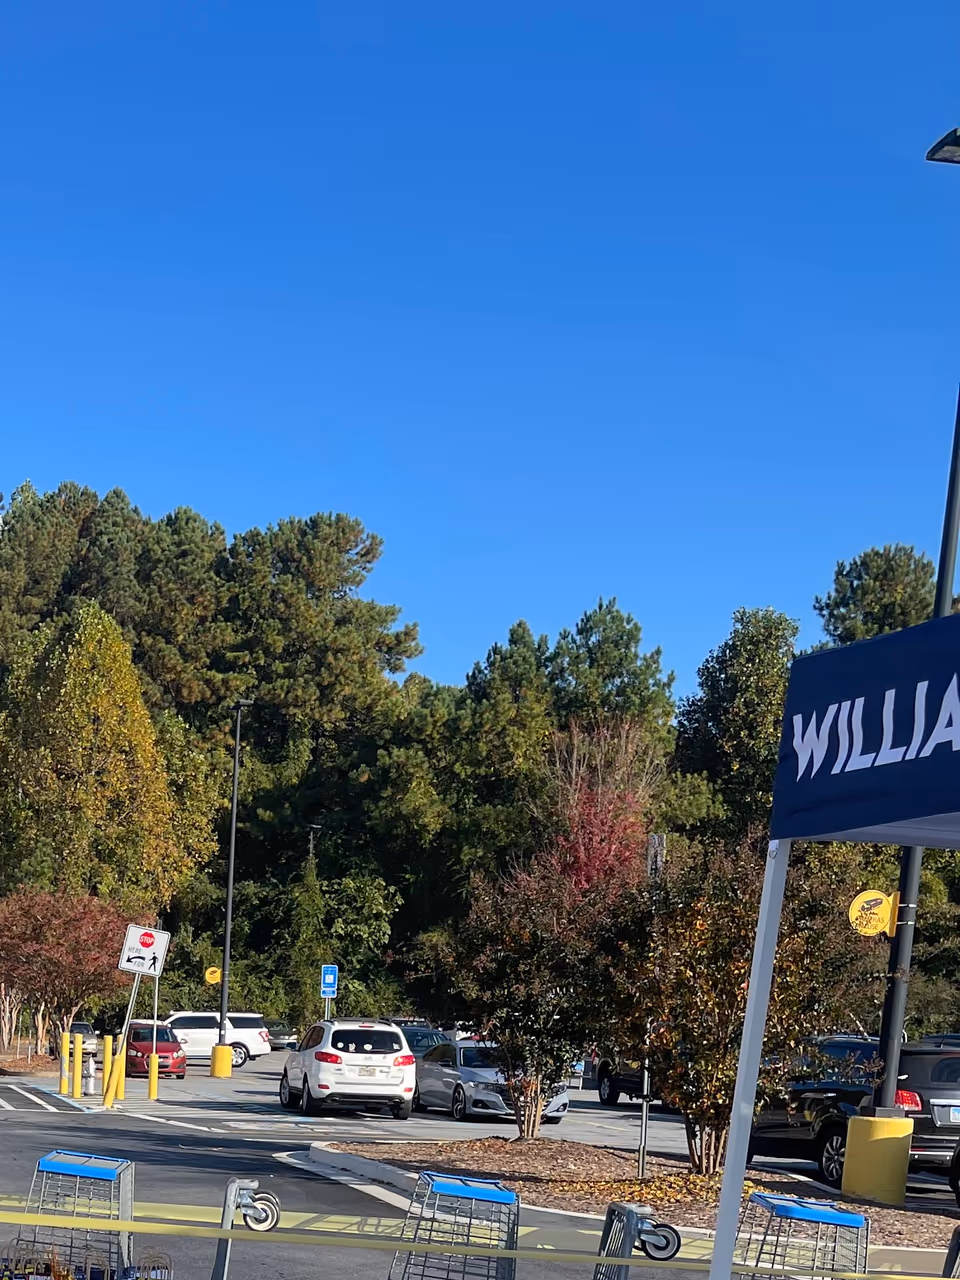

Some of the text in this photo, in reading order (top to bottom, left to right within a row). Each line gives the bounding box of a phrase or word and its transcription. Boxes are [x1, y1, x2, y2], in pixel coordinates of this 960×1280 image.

[140, 935, 155, 944] STOP
[128, 946, 142, 954] HERE
[133, 960, 145, 968] FOR
